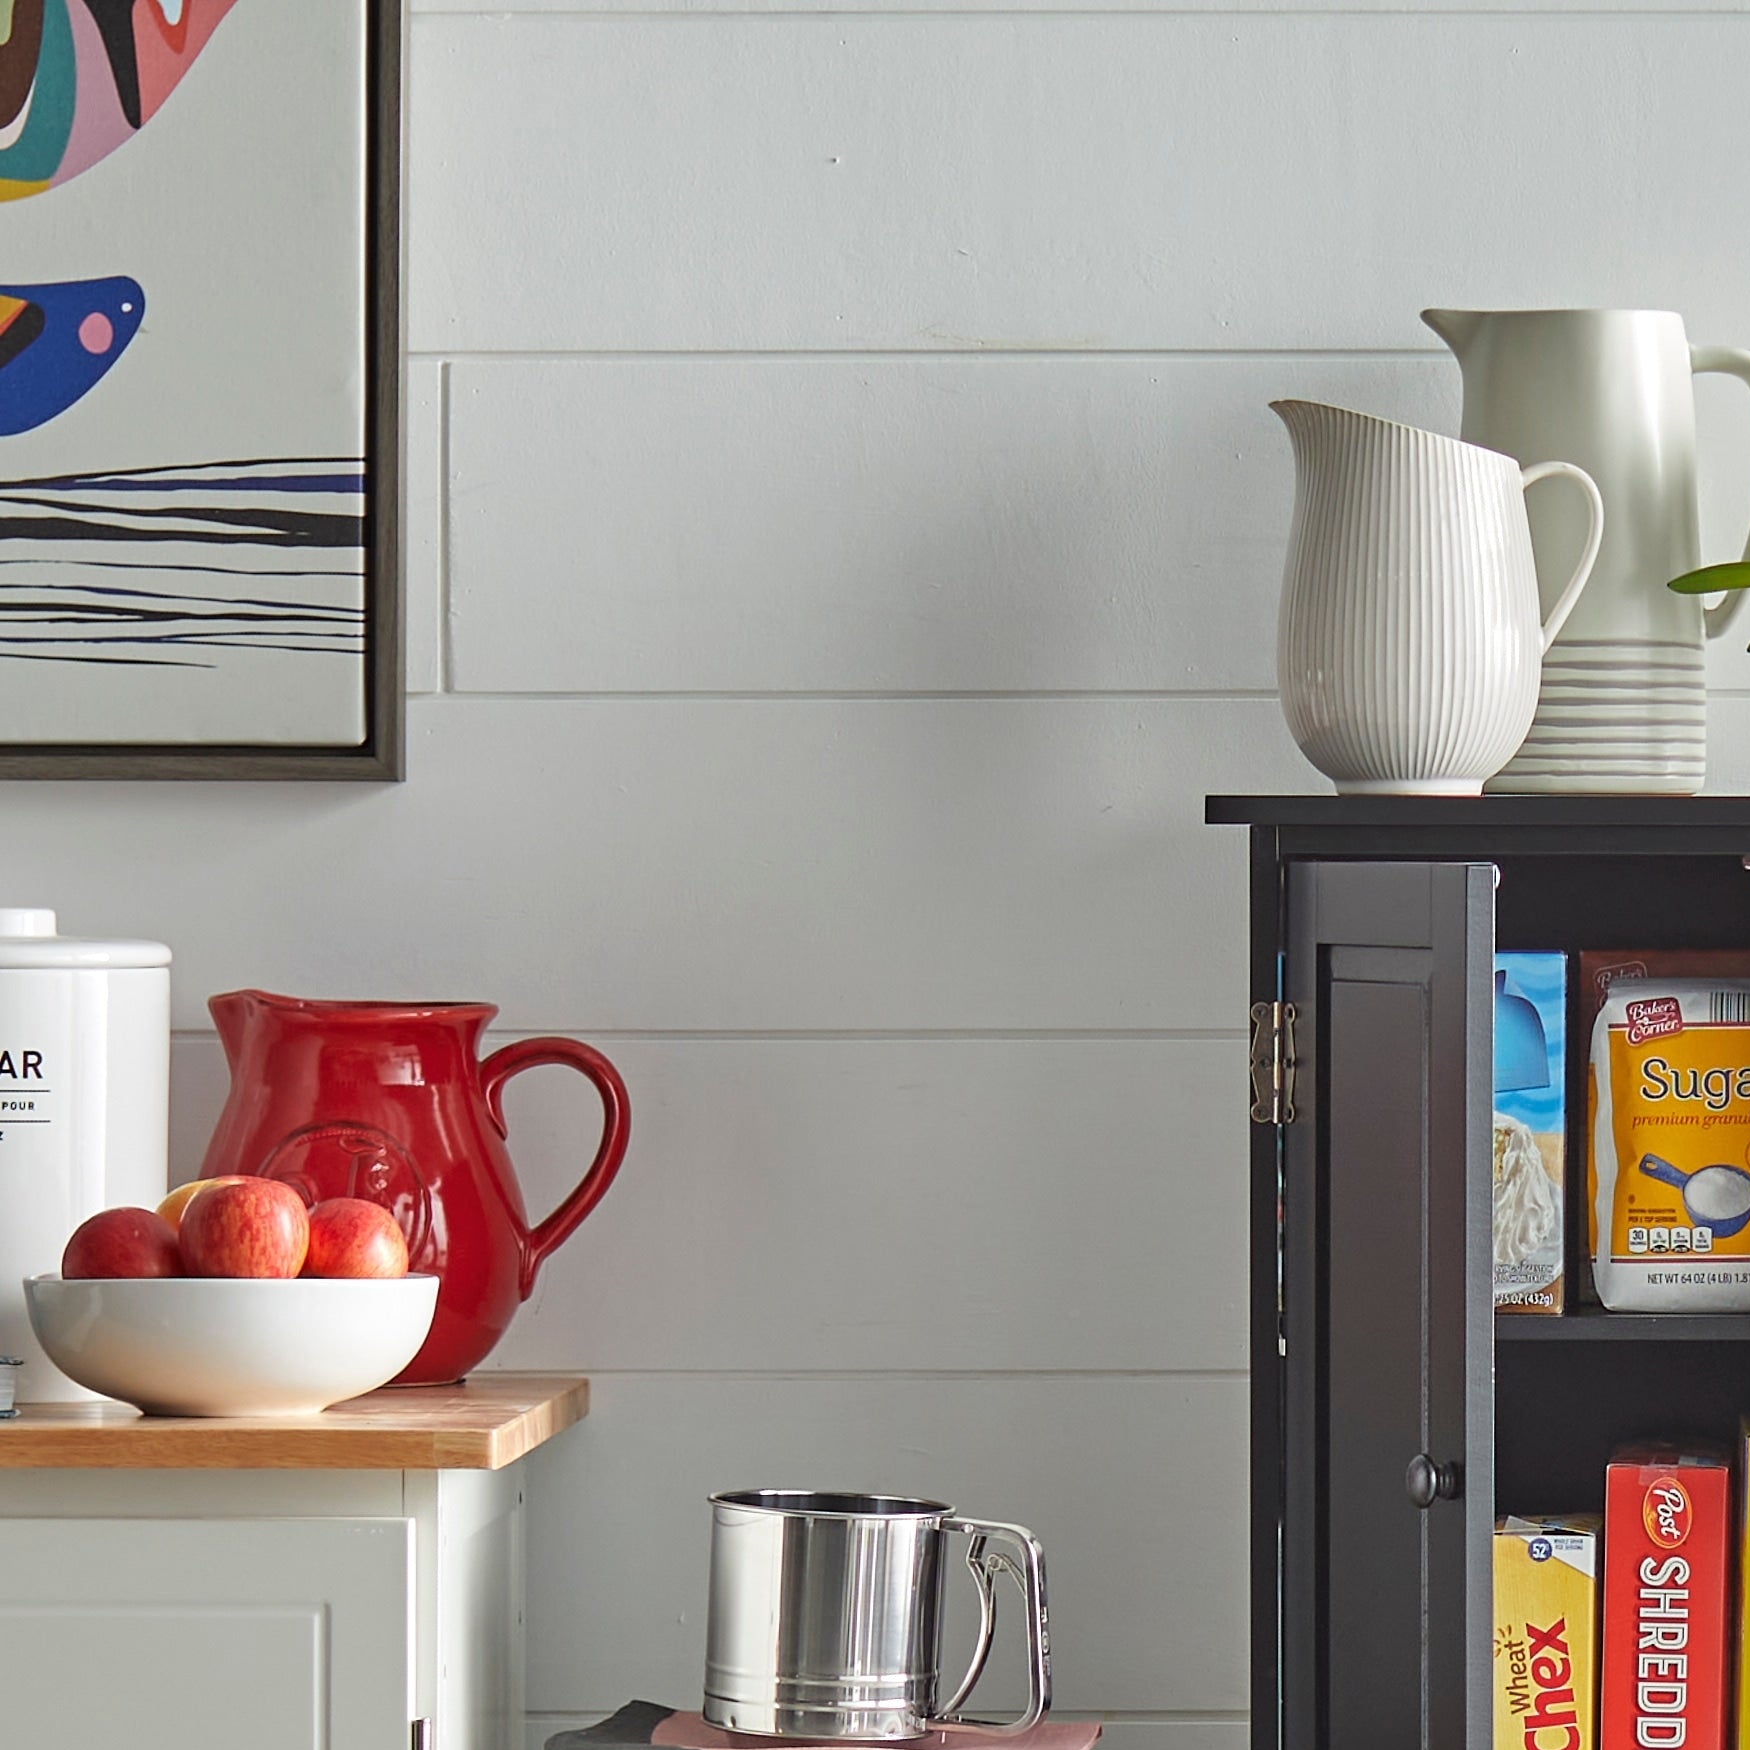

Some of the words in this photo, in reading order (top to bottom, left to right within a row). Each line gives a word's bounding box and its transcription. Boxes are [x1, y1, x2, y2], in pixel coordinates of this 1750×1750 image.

[1629, 1001, 1677, 1020] Baker's
[1630, 1020, 1679, 1042] Corner
[0, 1050, 43, 1079] AR
[2, 1101, 35, 1111] POUR
[1632, 1112, 1699, 1129] premium
[1632, 1230, 1644, 1240] 30
[1648, 1273, 1663, 1284] NET
[1664, 1273, 1679, 1284] WT
[1681, 1273, 1692, 1284] 64
[1693, 1273, 1705, 1284] OZ
[1707, 1273, 1716, 1285] (4
[1717, 1273, 1733, 1285] LB)
[1511, 1293, 1524, 1304] OZ
[1524, 1293, 1554, 1307] (432g)
[1653, 1488, 1685, 1540] Post
[1533, 1543, 1547, 1558] 52
[1504, 1640, 1531, 1715] Wheat
